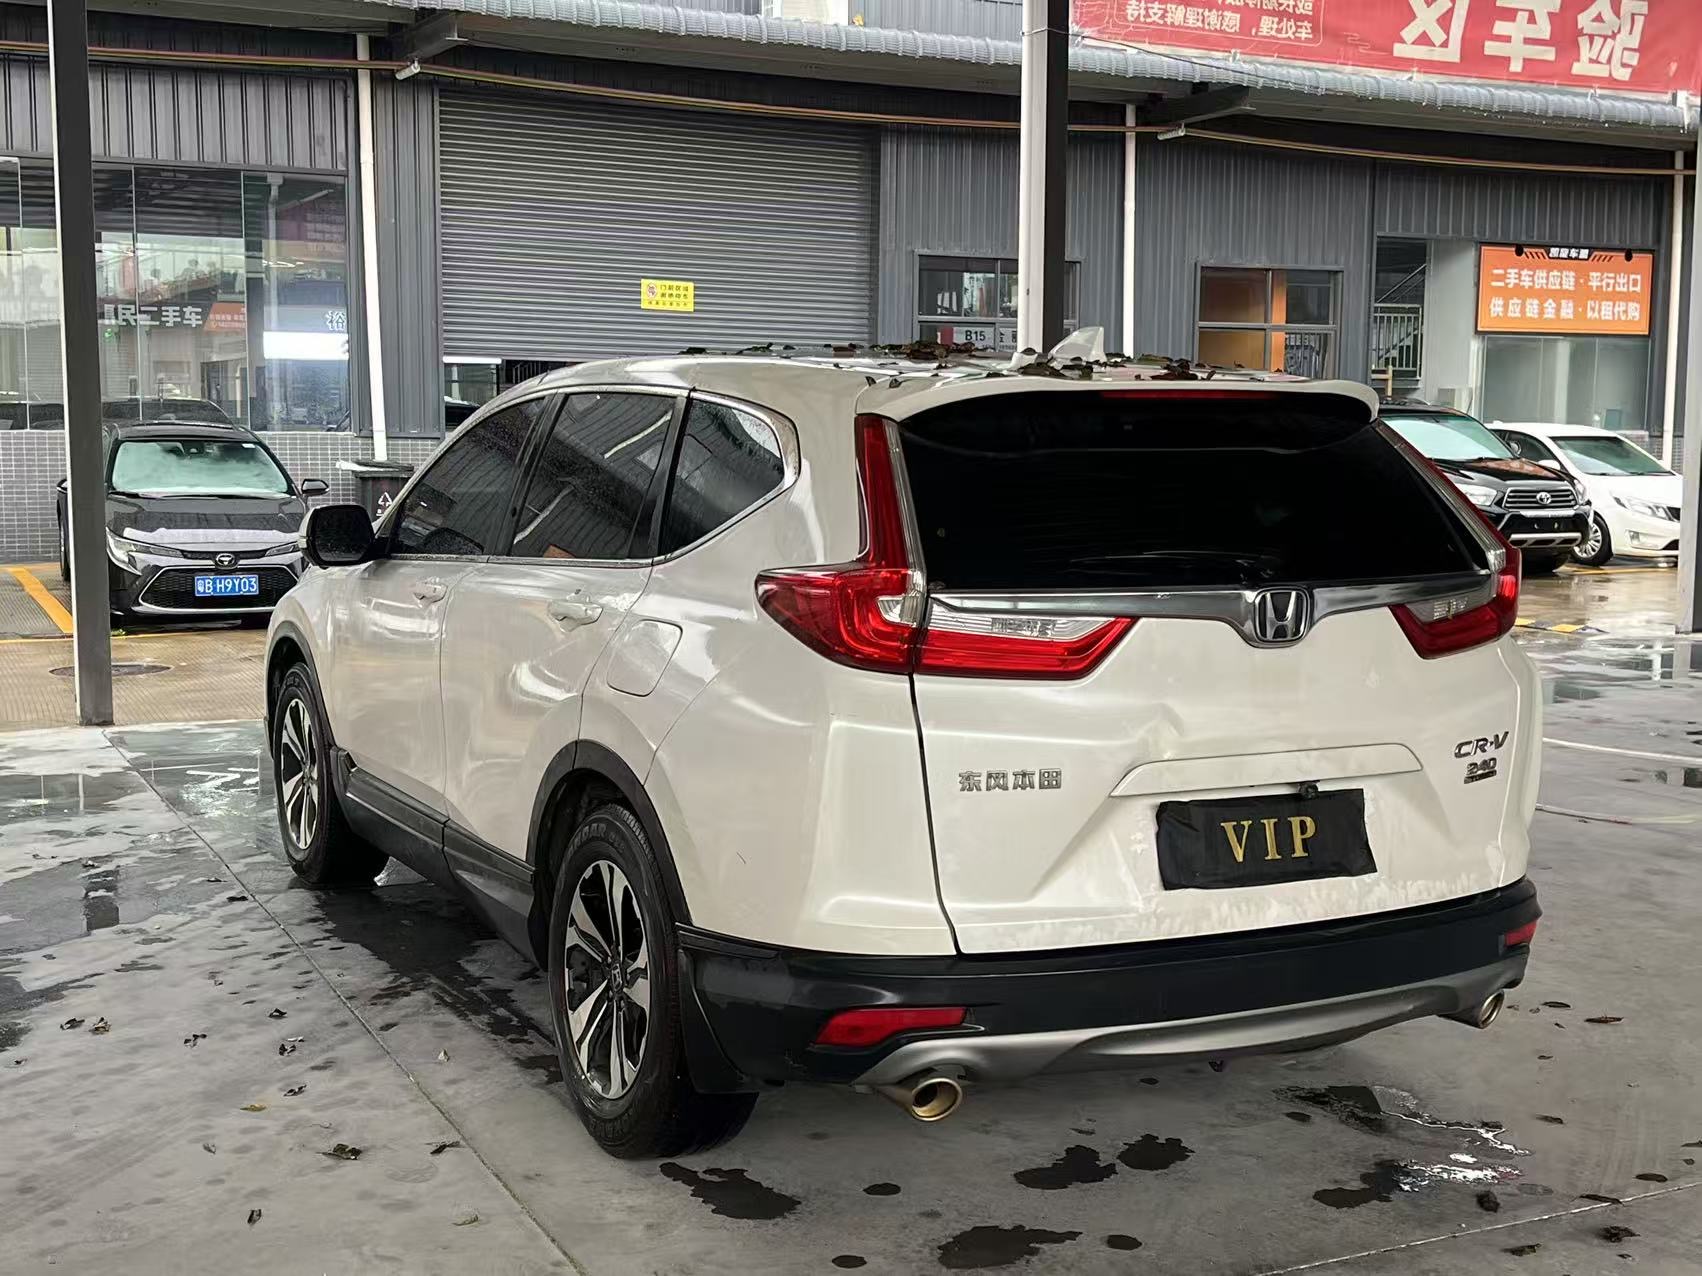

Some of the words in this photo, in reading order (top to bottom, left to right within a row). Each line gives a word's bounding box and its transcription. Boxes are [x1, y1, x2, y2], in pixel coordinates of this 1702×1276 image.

[965, 330, 986, 342] B15
[1466, 757, 1497, 775] 240
[959, 768, 1061, 791] 东风本田
[1220, 816, 1317, 862] VIP
